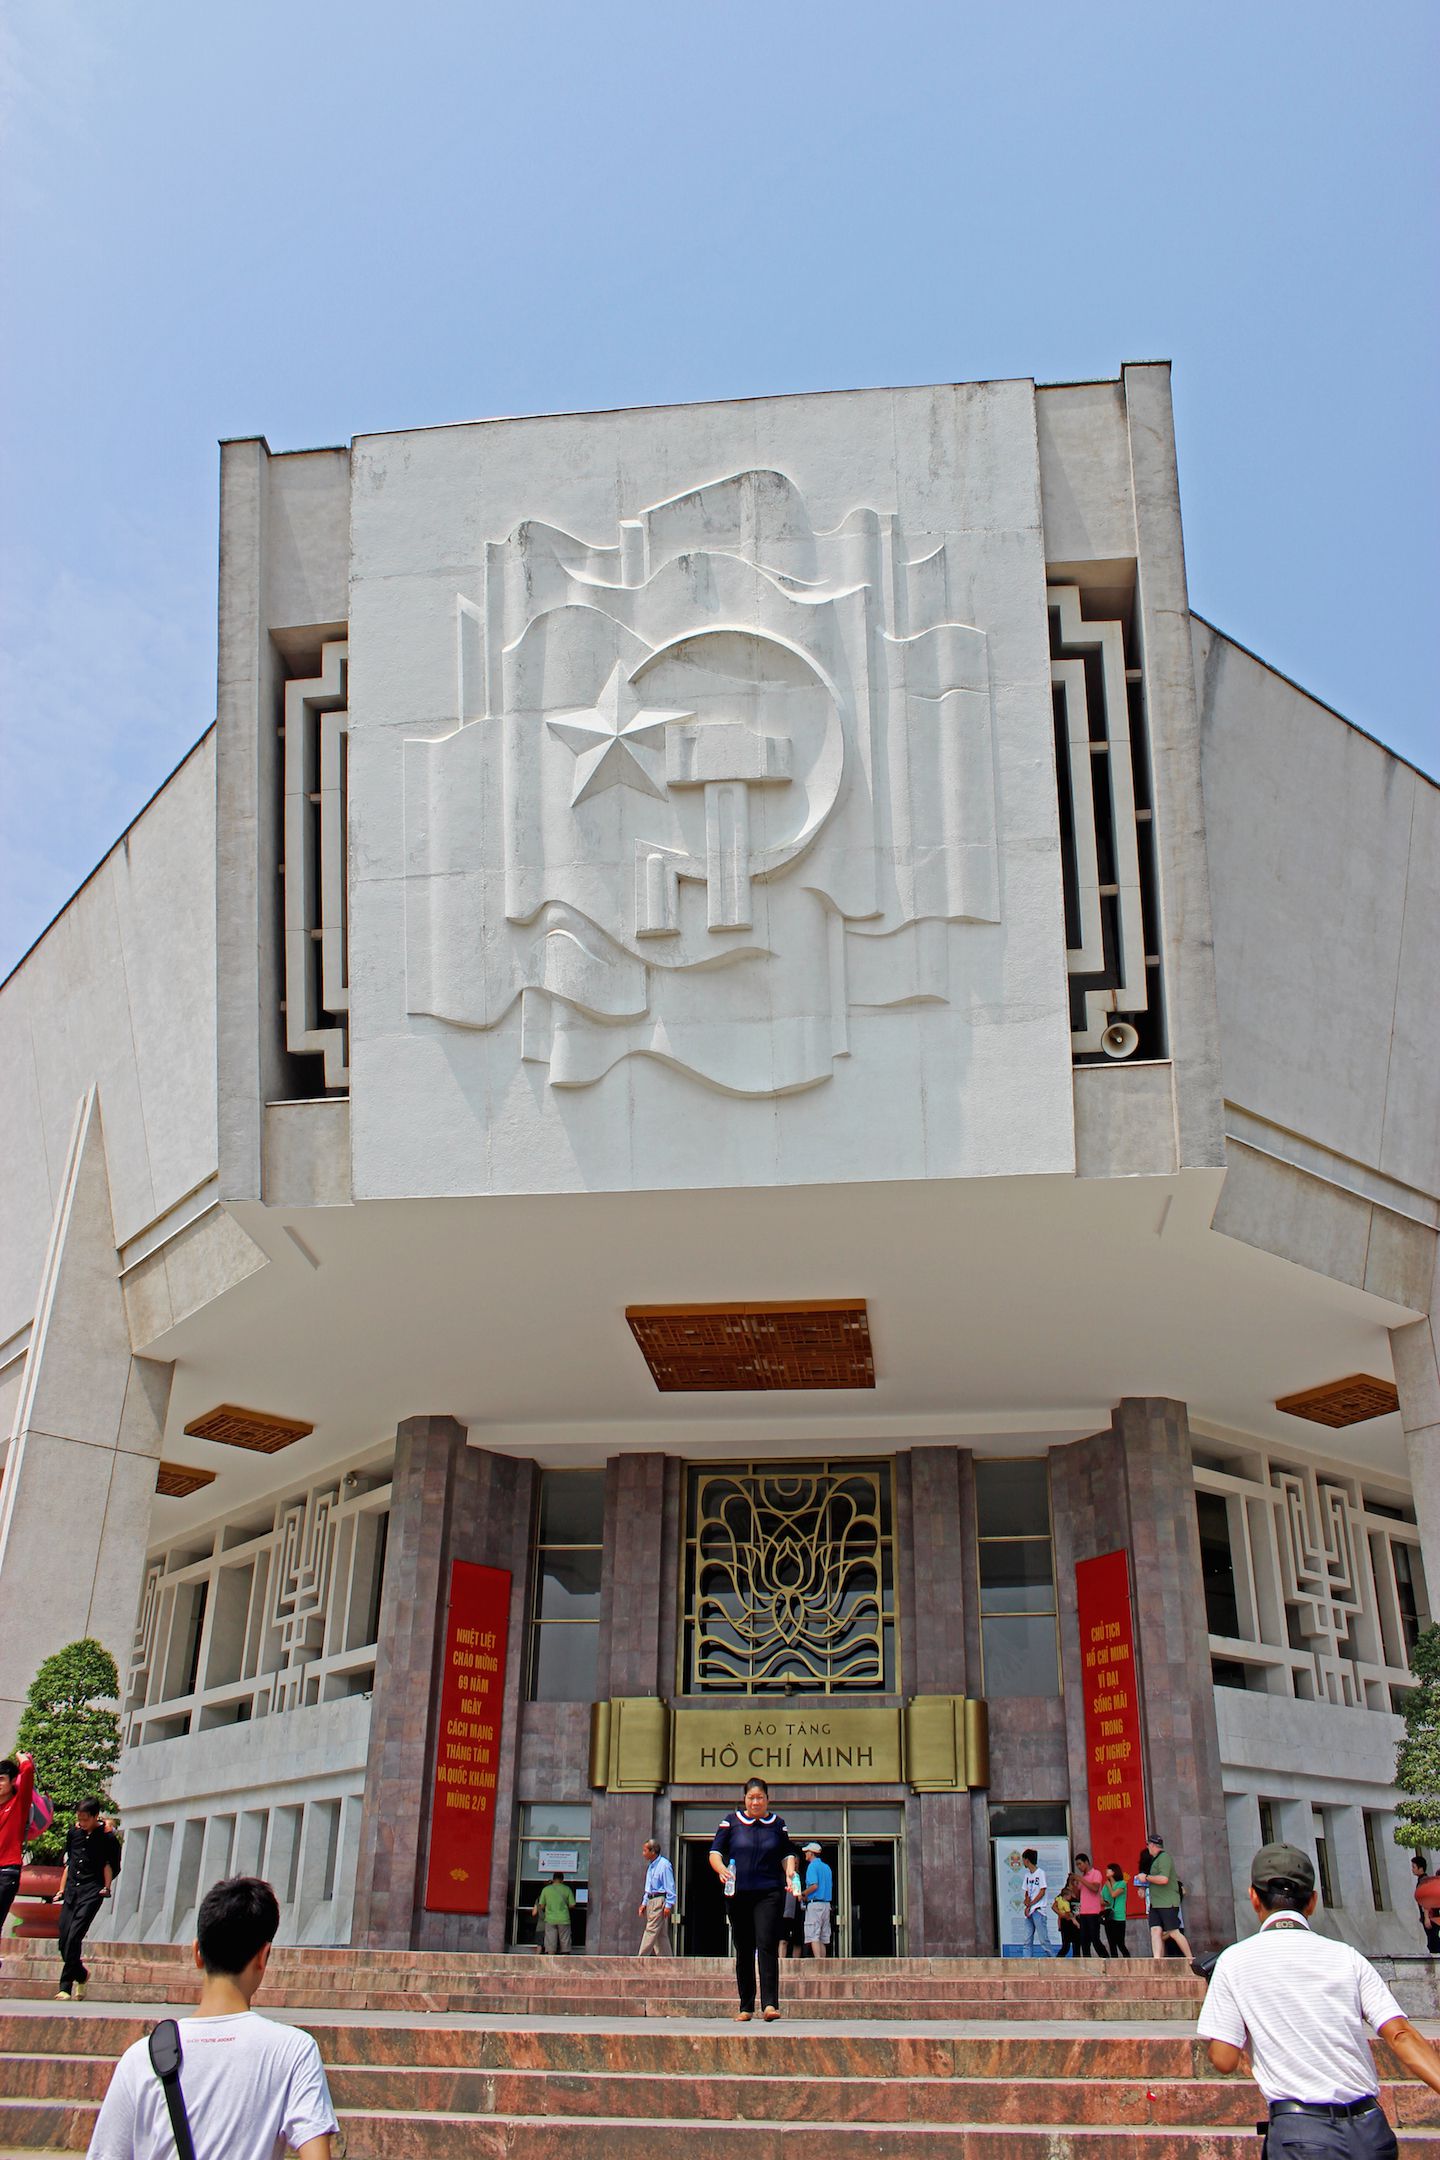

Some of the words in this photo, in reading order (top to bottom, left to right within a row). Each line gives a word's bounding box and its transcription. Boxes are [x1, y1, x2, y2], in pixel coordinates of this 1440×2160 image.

[456, 1628, 479, 1648] NHIỆT
[480, 1631, 496, 1651] LIỆT
[1091, 1620, 1105, 1642] CHỦ
[1105, 1622, 1120, 1642] TỊCH
[453, 1649, 474, 1668] CHÀO
[475, 1653, 498, 1672] MỪNG
[1110, 1644, 1129, 1662] MINH
[458, 1674, 468, 1690] 69
[470, 1675, 489, 1694] NĂM
[461, 1697, 482, 1716] NGÀY
[1093, 1693, 1112, 1714] SỐNG
[447, 1718, 468, 1737] CÁCH
[470, 1723, 493, 1742] MẠNG
[744, 1721, 777, 1736] BẢO
[786, 1721, 831, 1736] TÀNG
[1100, 1718, 1124, 1737] TRONG
[446, 1742, 472, 1761] THÁNG
[473, 1745, 489, 1764] TÁM
[701, 1742, 739, 1768] HỒ
[749, 1743, 792, 1768] CHÍ
[803, 1746, 873, 1768] MINH
[1106, 1739, 1132, 1761] NGHIỆP
[438, 1764, 447, 1782] VÀ
[447, 1765, 467, 1785] QUỐC
[468, 1769, 496, 1789] KHÁNH
[1107, 1763, 1122, 1785] CỦA
[472, 1795, 486, 1811] 2/9
[1097, 1791, 1121, 1811] CHÚNG
[1122, 1792, 1132, 1808] TA
[1275, 1920, 1295, 1929] EOS
